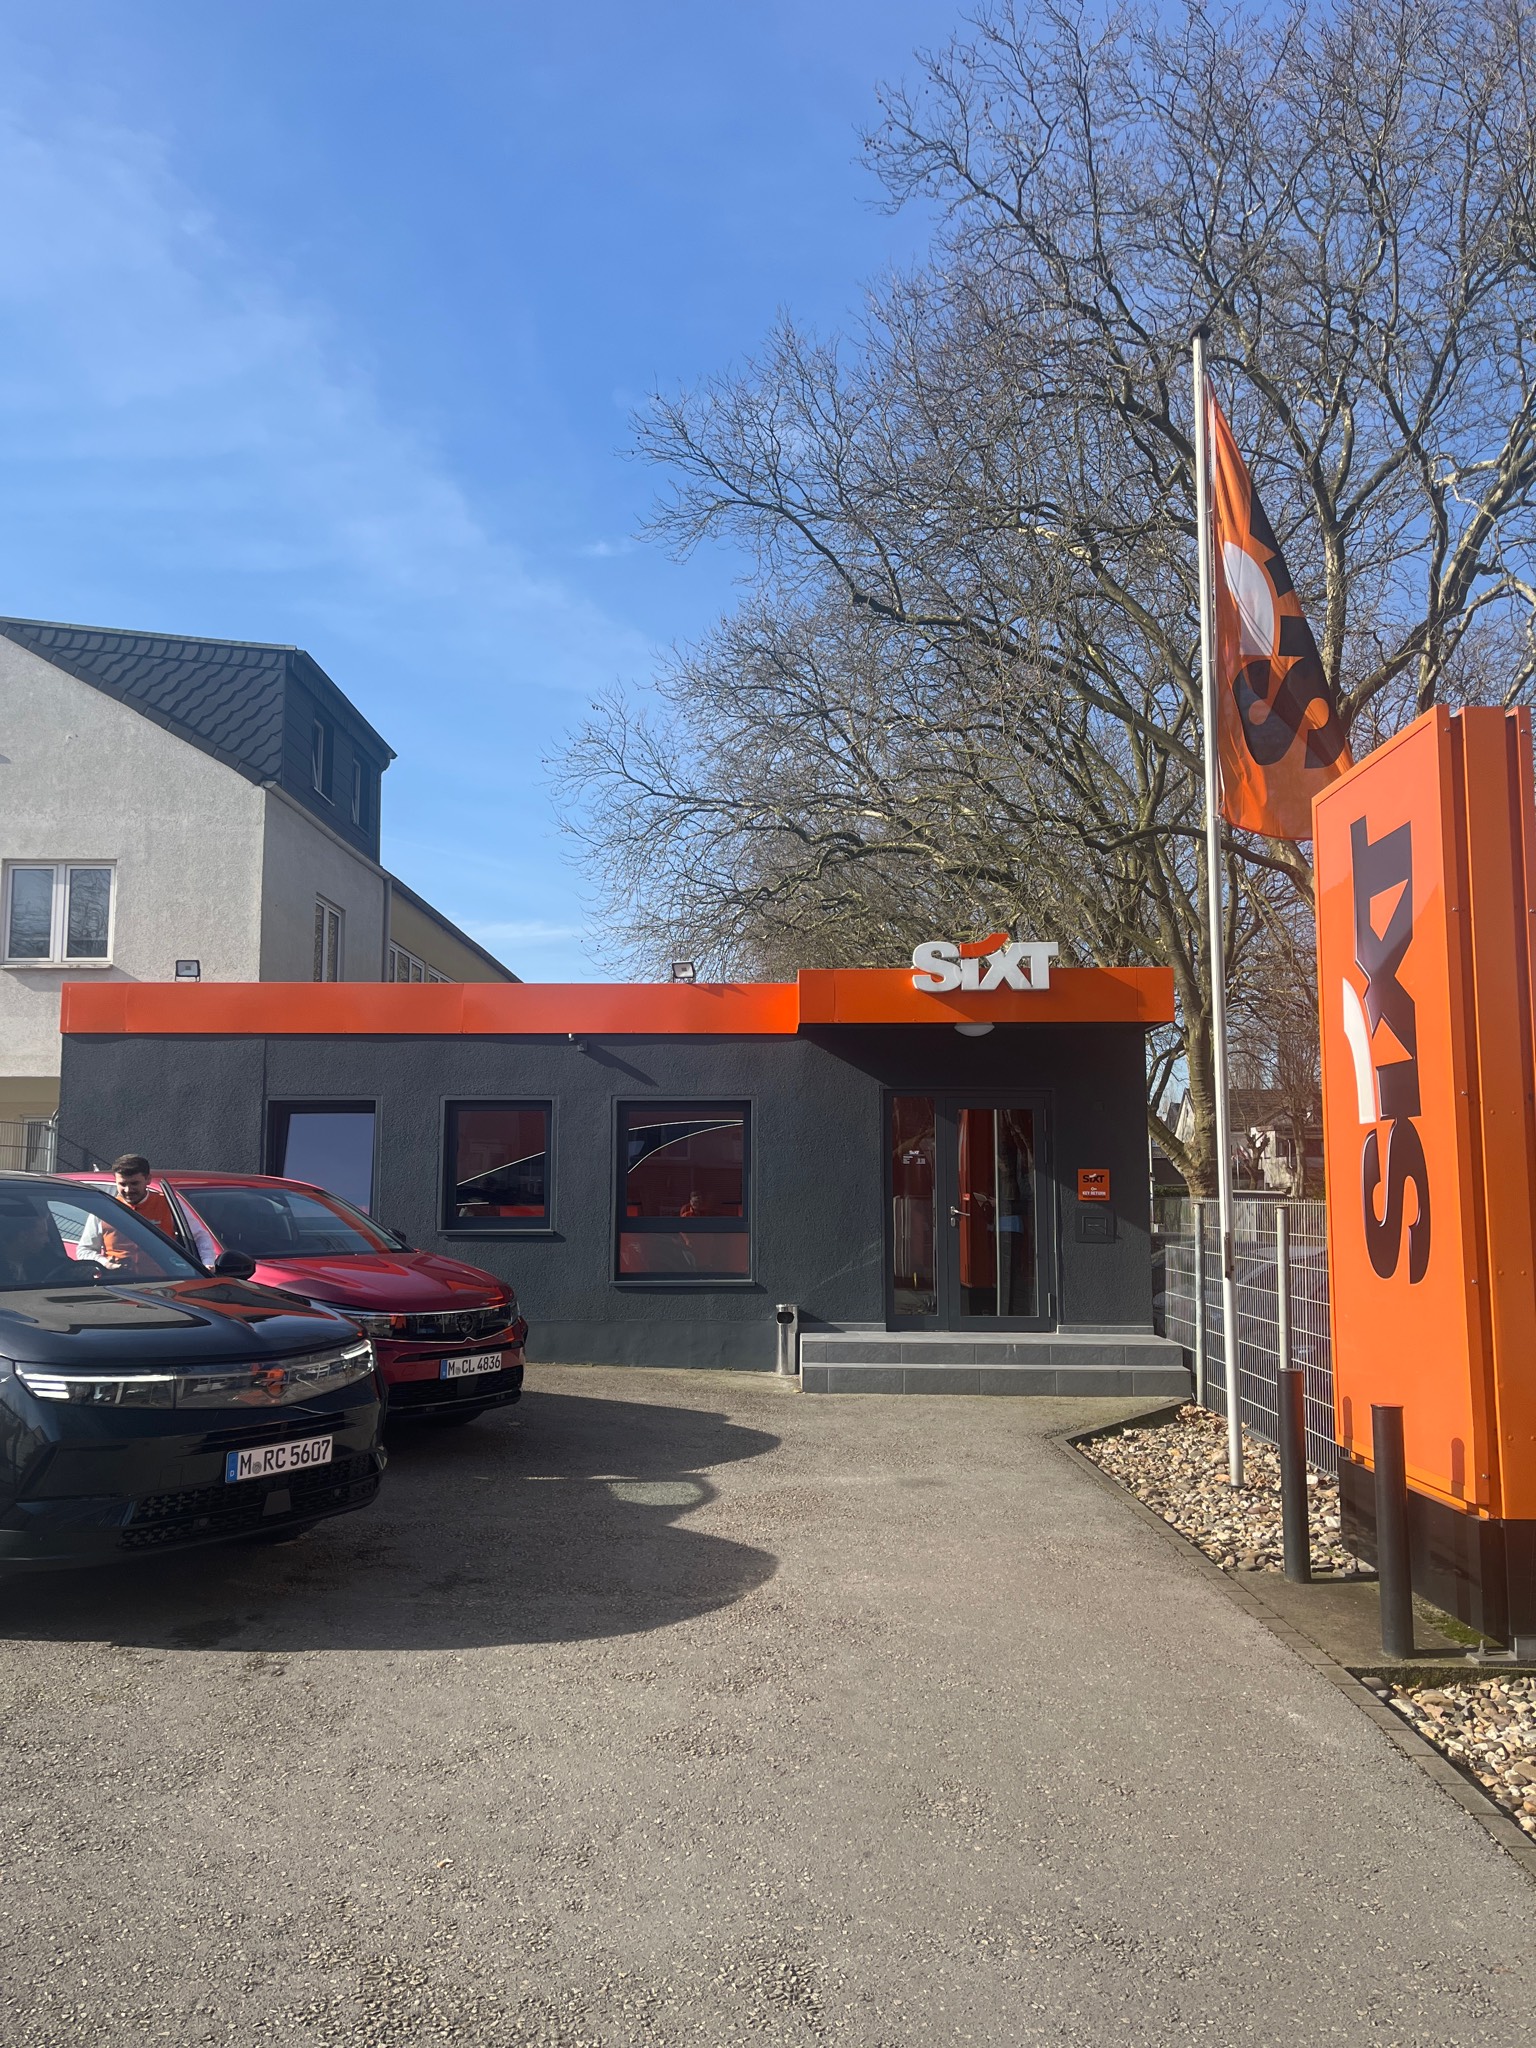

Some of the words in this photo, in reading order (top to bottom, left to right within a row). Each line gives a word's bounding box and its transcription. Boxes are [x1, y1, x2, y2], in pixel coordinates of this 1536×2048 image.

[447, 1361, 455, 1376] M
[462, 1359, 475, 1374] CL
[477, 1355, 500, 1371] 4836
[240, 1453, 252, 1476] M
[263, 1447, 286, 1472] RC
[290, 1439, 331, 1466] 5607
